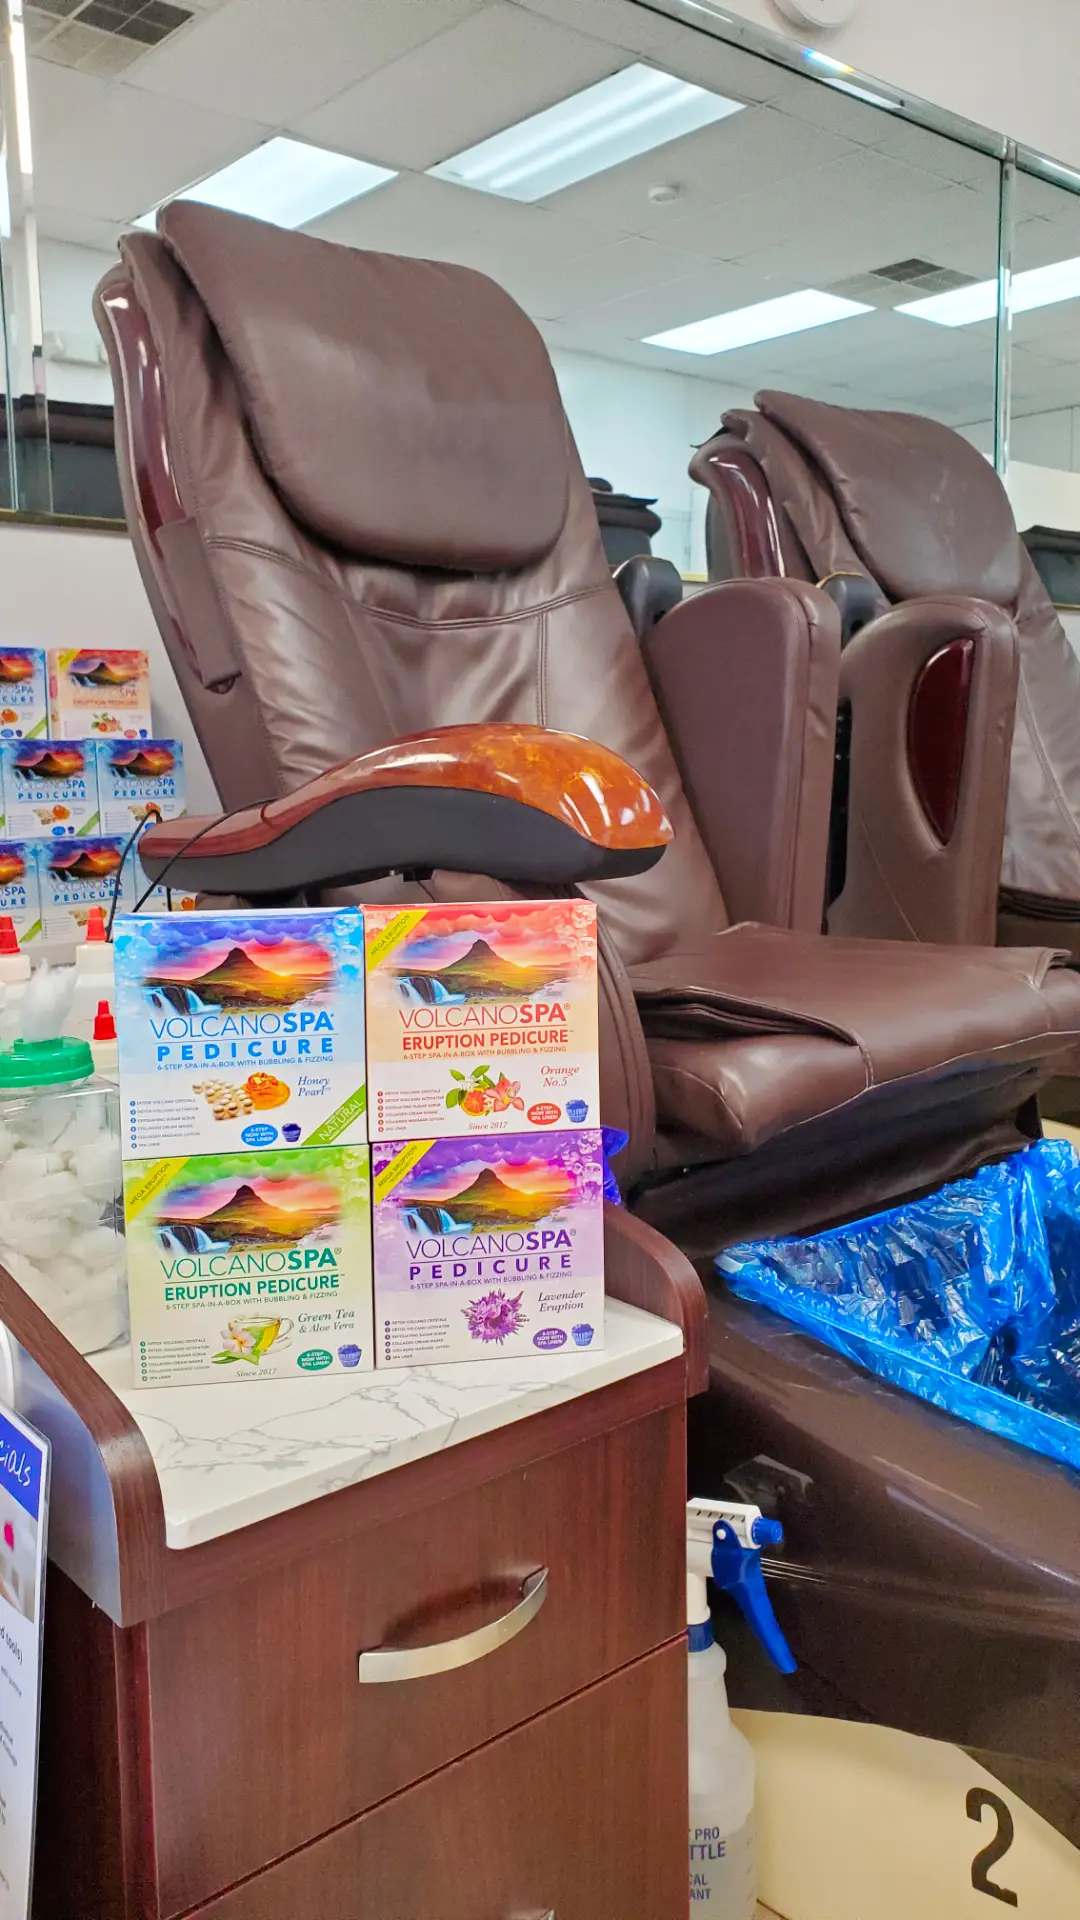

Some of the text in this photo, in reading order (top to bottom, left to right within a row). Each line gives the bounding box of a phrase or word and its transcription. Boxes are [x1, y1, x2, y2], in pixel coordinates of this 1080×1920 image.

[398, 1002, 567, 1029] VOLCANOSPA
[150, 1011, 334, 1039] VOLCANOSPA
[402, 1029, 569, 1051] ERUPTION PEDICURE
[157, 1037, 333, 1062] PEDICURE
[477, 1049, 495, 1057] WITH
[236, 1059, 257, 1067] WITH
[540, 1065, 580, 1077] Orange
[297, 1075, 331, 1087] Honey
[543, 1077, 568, 1088] No.5
[318, 1099, 364, 1141] NATURAL
[490, 1121, 508, 1129] 2017
[406, 1229, 573, 1259] VOLCANOSPA
[160, 1247, 338, 1279] VOLCANOSPA
[409, 1254, 572, 1281] PEDICURE
[483, 1277, 502, 1285] WITH
[503, 1274, 538, 1283] BUBBLING
[546, 1271, 572, 1279] FIZZING
[164, 1274, 340, 1302] ERUPTION PEDICURE
[538, 1289, 586, 1302] Lavender
[243, 1297, 262, 1305] WITH
[264, 1294, 301, 1303] BUBBLING
[309, 1291, 338, 1299] FIZZING
[539, 1300, 584, 1313] Eruption
[298, 1308, 355, 1323] Green Tea
[309, 1323, 331, 1333] Aloe
[333, 1321, 355, 1331] Vera
[258, 1368, 278, 1376] 2017
[694, 1826, 720, 1841] PRO
[689, 1840, 726, 1861] TTLE
[965, 1786, 1019, 1909] 2
